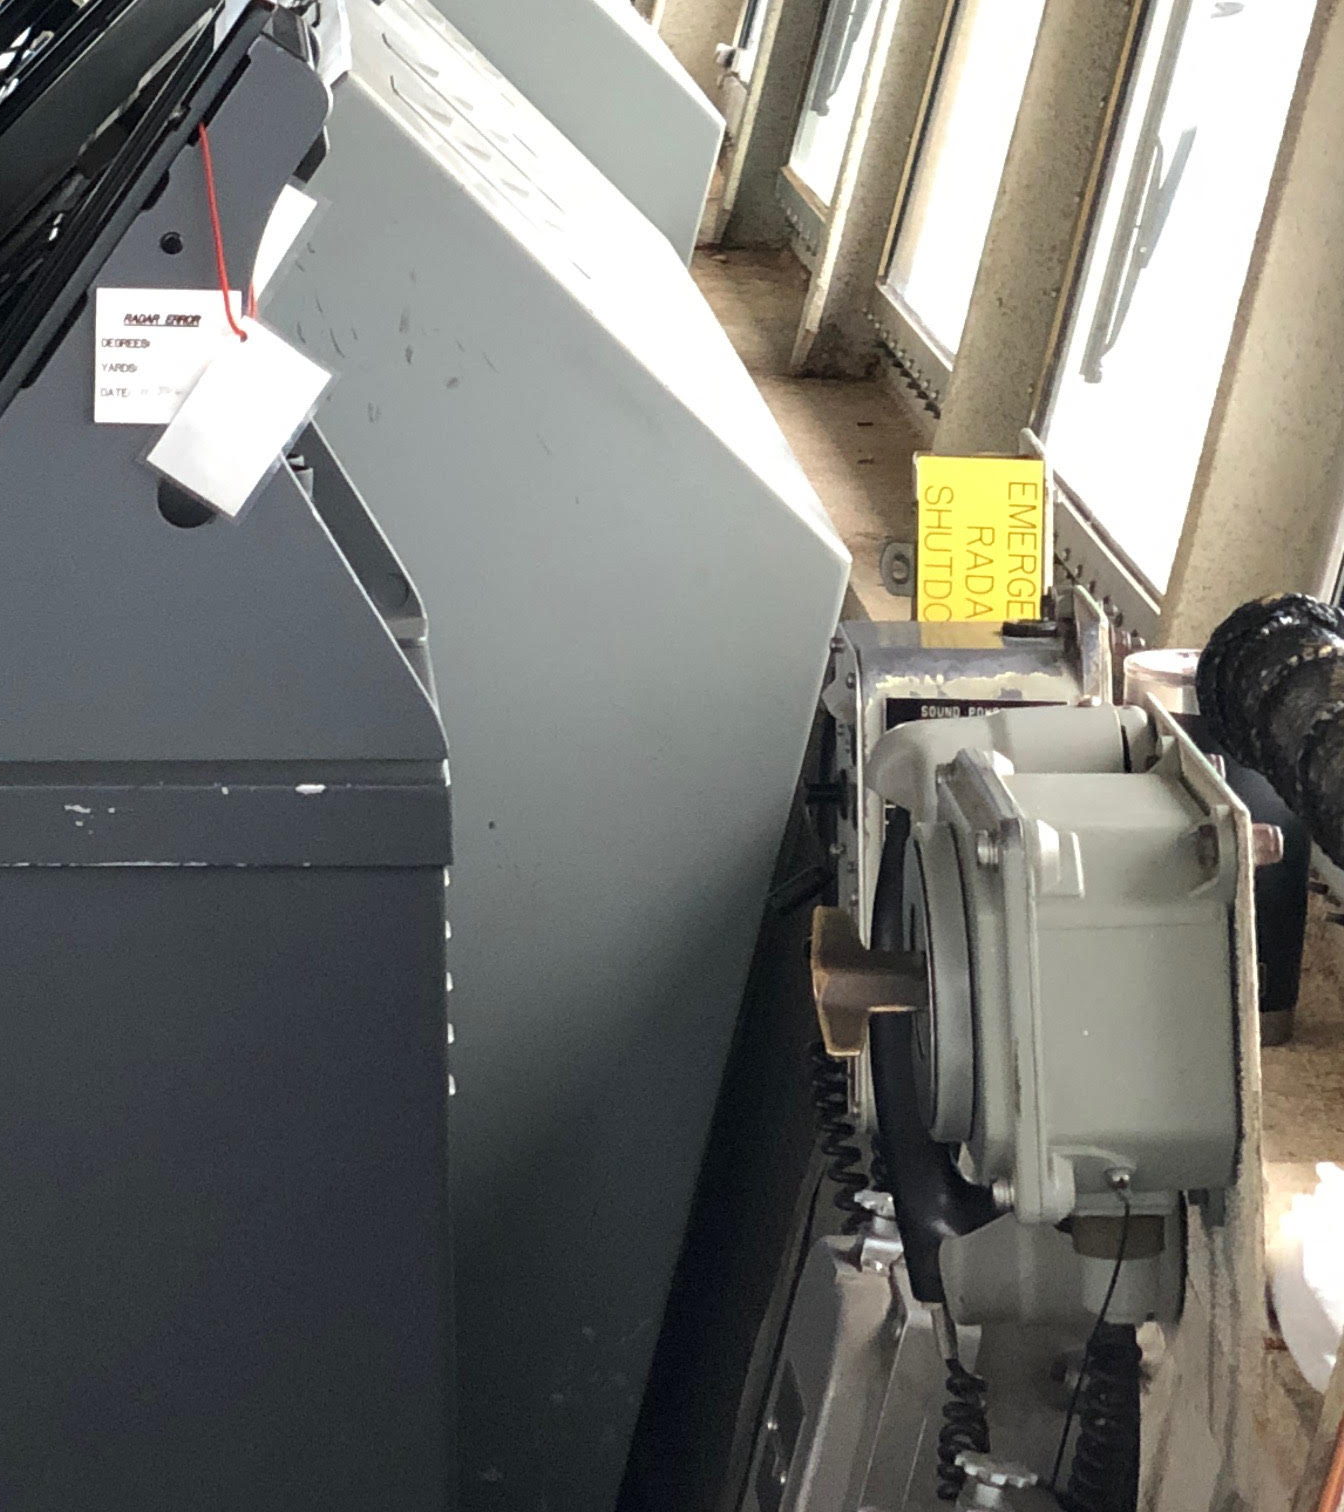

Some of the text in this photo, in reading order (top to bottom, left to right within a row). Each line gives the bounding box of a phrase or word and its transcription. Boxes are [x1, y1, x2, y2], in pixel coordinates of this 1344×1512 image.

[124, 314, 202, 326] RADAR ERROR
[964, 525, 996, 620] RADA
[920, 705, 961, 718] SOUND
